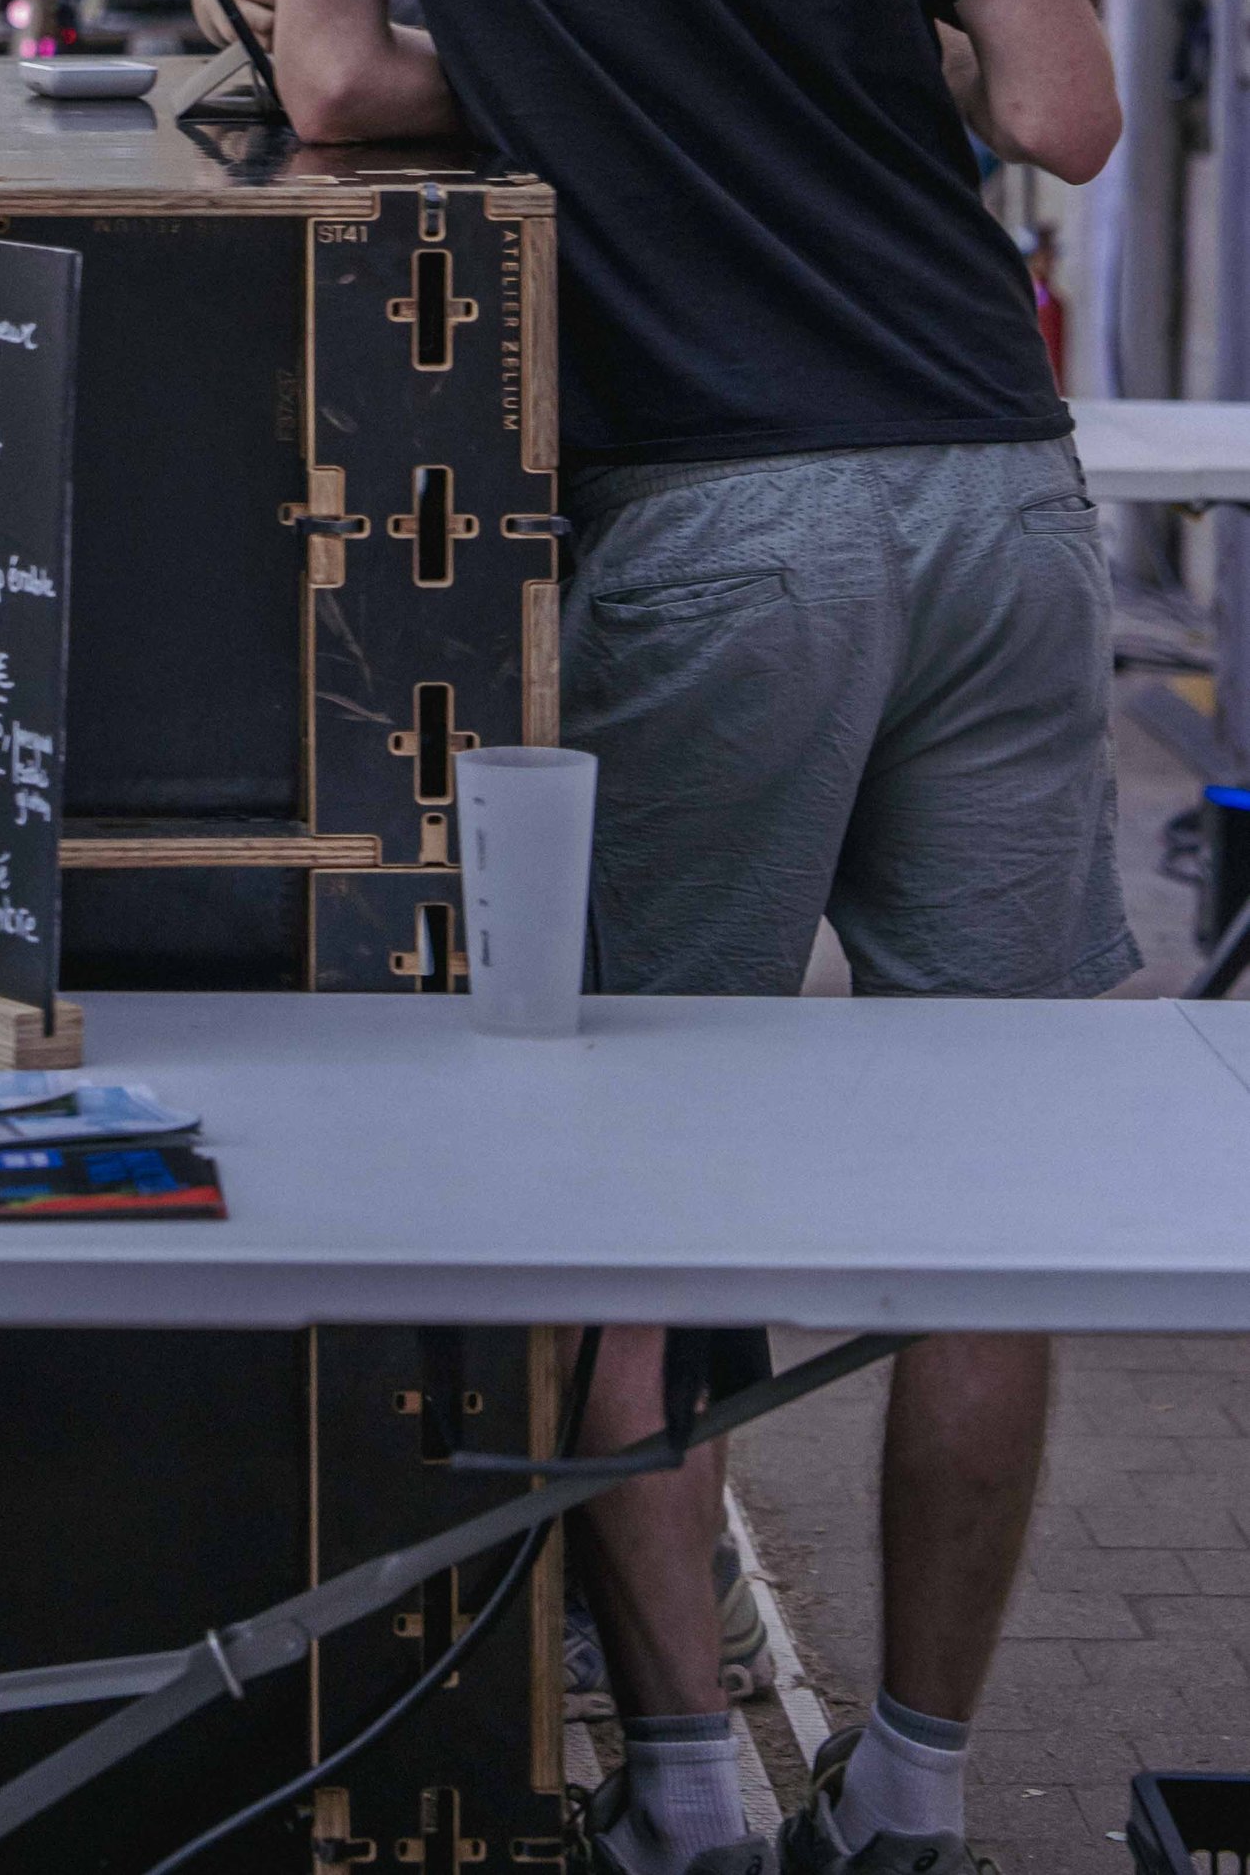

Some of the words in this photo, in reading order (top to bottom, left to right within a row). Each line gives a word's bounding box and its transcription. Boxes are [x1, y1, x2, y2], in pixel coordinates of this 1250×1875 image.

[317, 225, 368, 243] ST41
[502, 229, 520, 327] ATELIER
[502, 341, 520, 431] ZELIUM
